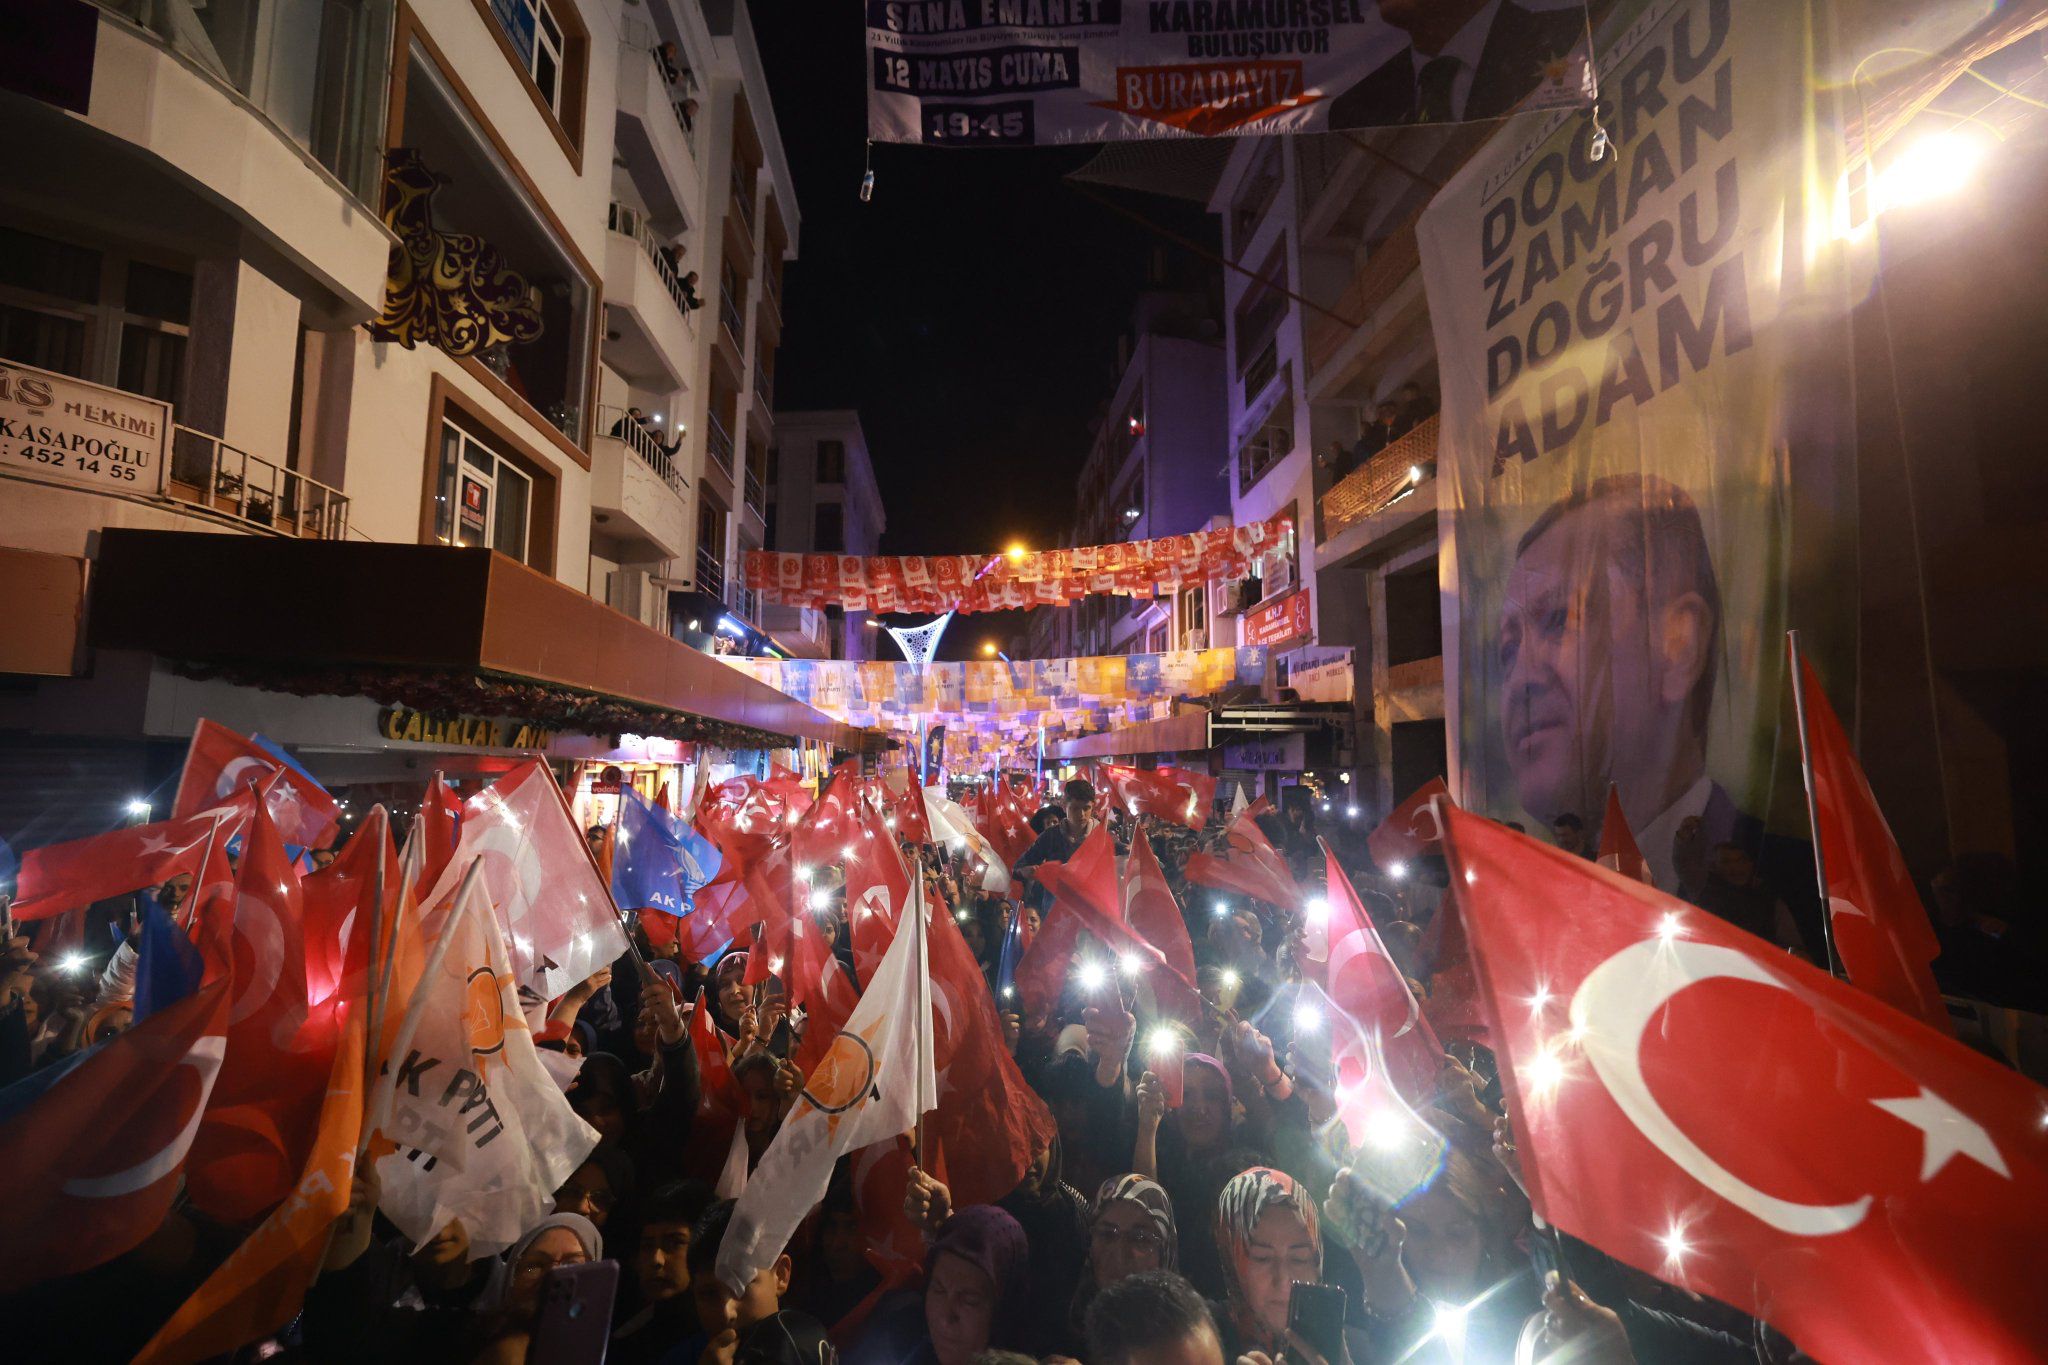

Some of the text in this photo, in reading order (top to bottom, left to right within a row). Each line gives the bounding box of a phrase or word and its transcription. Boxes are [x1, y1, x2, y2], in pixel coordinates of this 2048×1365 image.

[886, 0, 1102, 33] SANA EMANET
[1187, 29, 1329, 58] BULUŞUYOR
[885, 52, 1069, 89] 12 MAYIS CUMA
[1125, 68, 1298, 110] BURADAYIZ
[932, 111, 1024, 138] 19:45
[1483, 0, 1731, 270] DOĞRU
[1484, 57, 1733, 331] ZAMAN
[1488, 157, 1740, 405] DOĞRU
[1491, 252, 1753, 479] ADAM
[20, 446, 65, 467] 452
[76, 457, 100, 474] 14
[110, 465, 136, 481] 55
[1265, 605, 1283, 622] M.H.P
[592, 785, 620, 793] vodafo
[650, 892, 676, 909] AK
